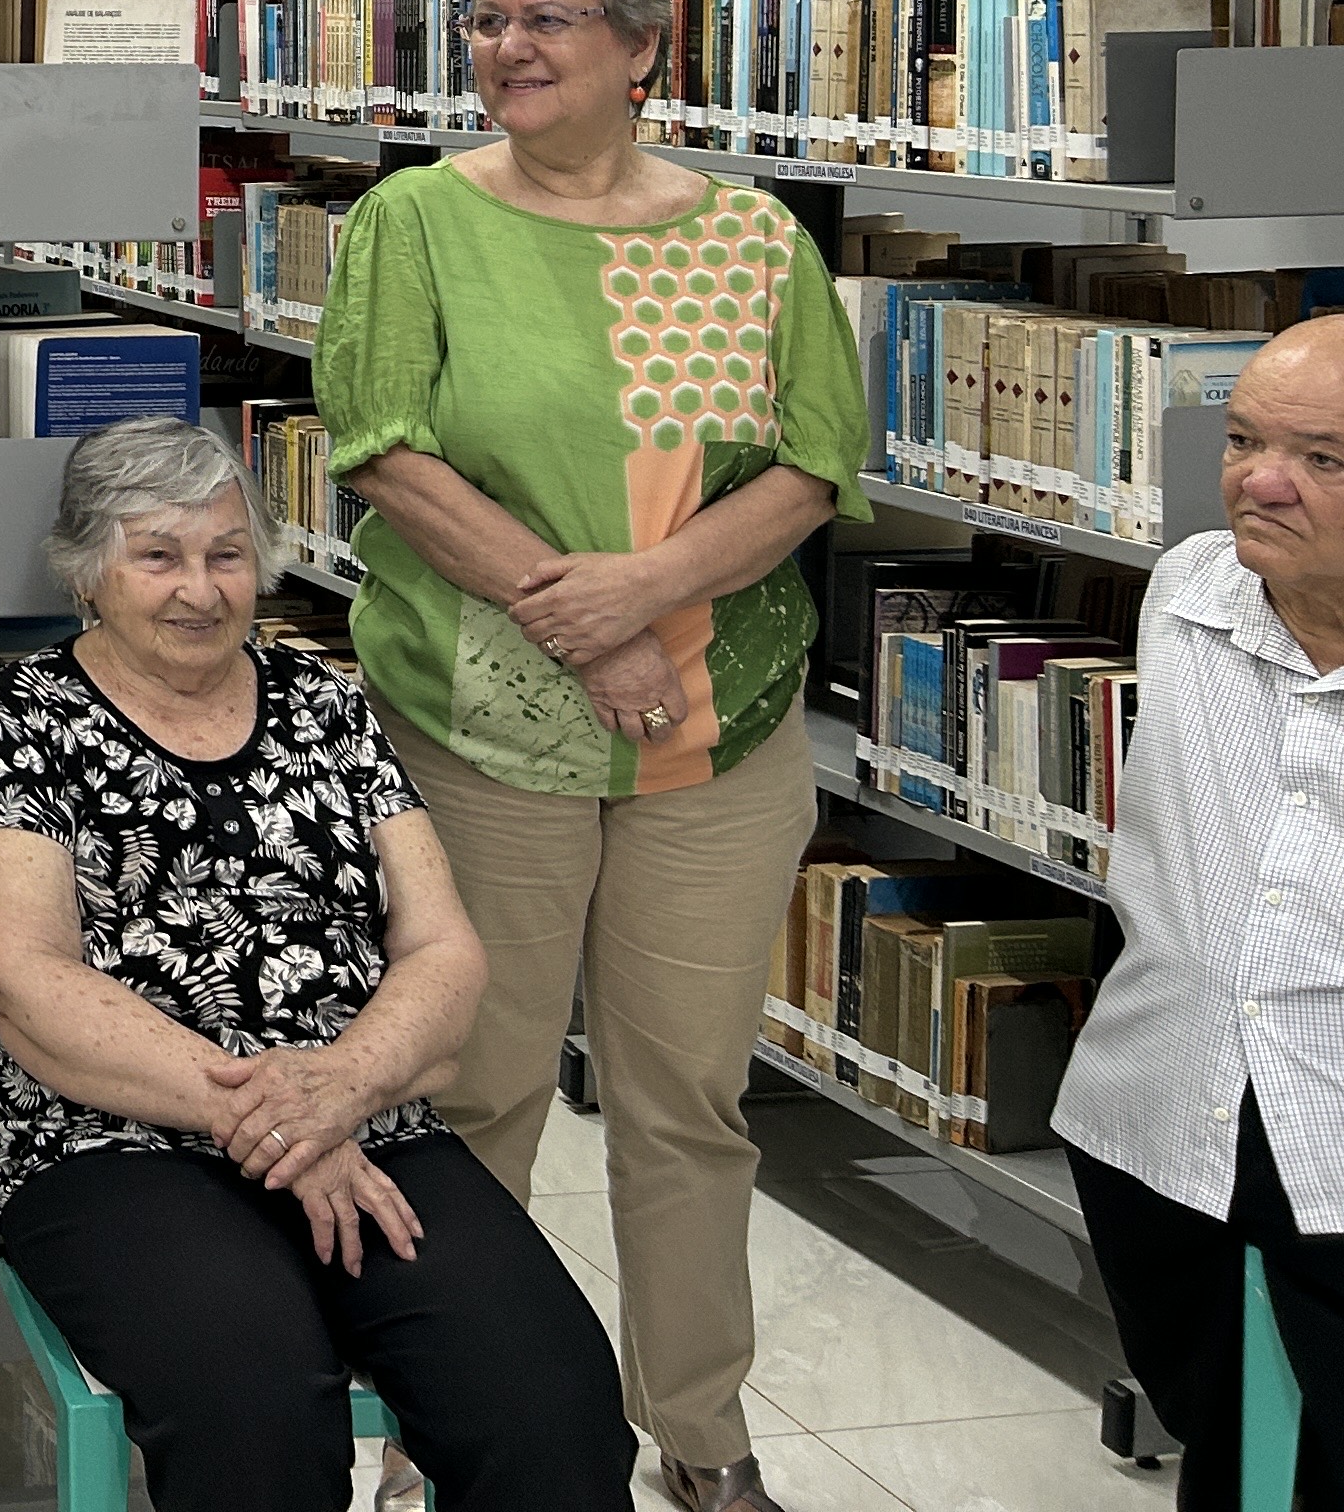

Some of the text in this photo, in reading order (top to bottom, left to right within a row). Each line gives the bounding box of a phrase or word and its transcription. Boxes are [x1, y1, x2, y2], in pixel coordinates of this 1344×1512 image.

[1030, 22, 1044, 99] CHOCOLAT
[790, 165, 826, 177] LITERATURA
[828, 167, 854, 178] INGLESA
[205, 196, 242, 206] TREIN
[200, 342, 260, 372] dando
[978, 511, 1020, 533] LITERATURA
[1021, 521, 1059, 541] FRANCESA
